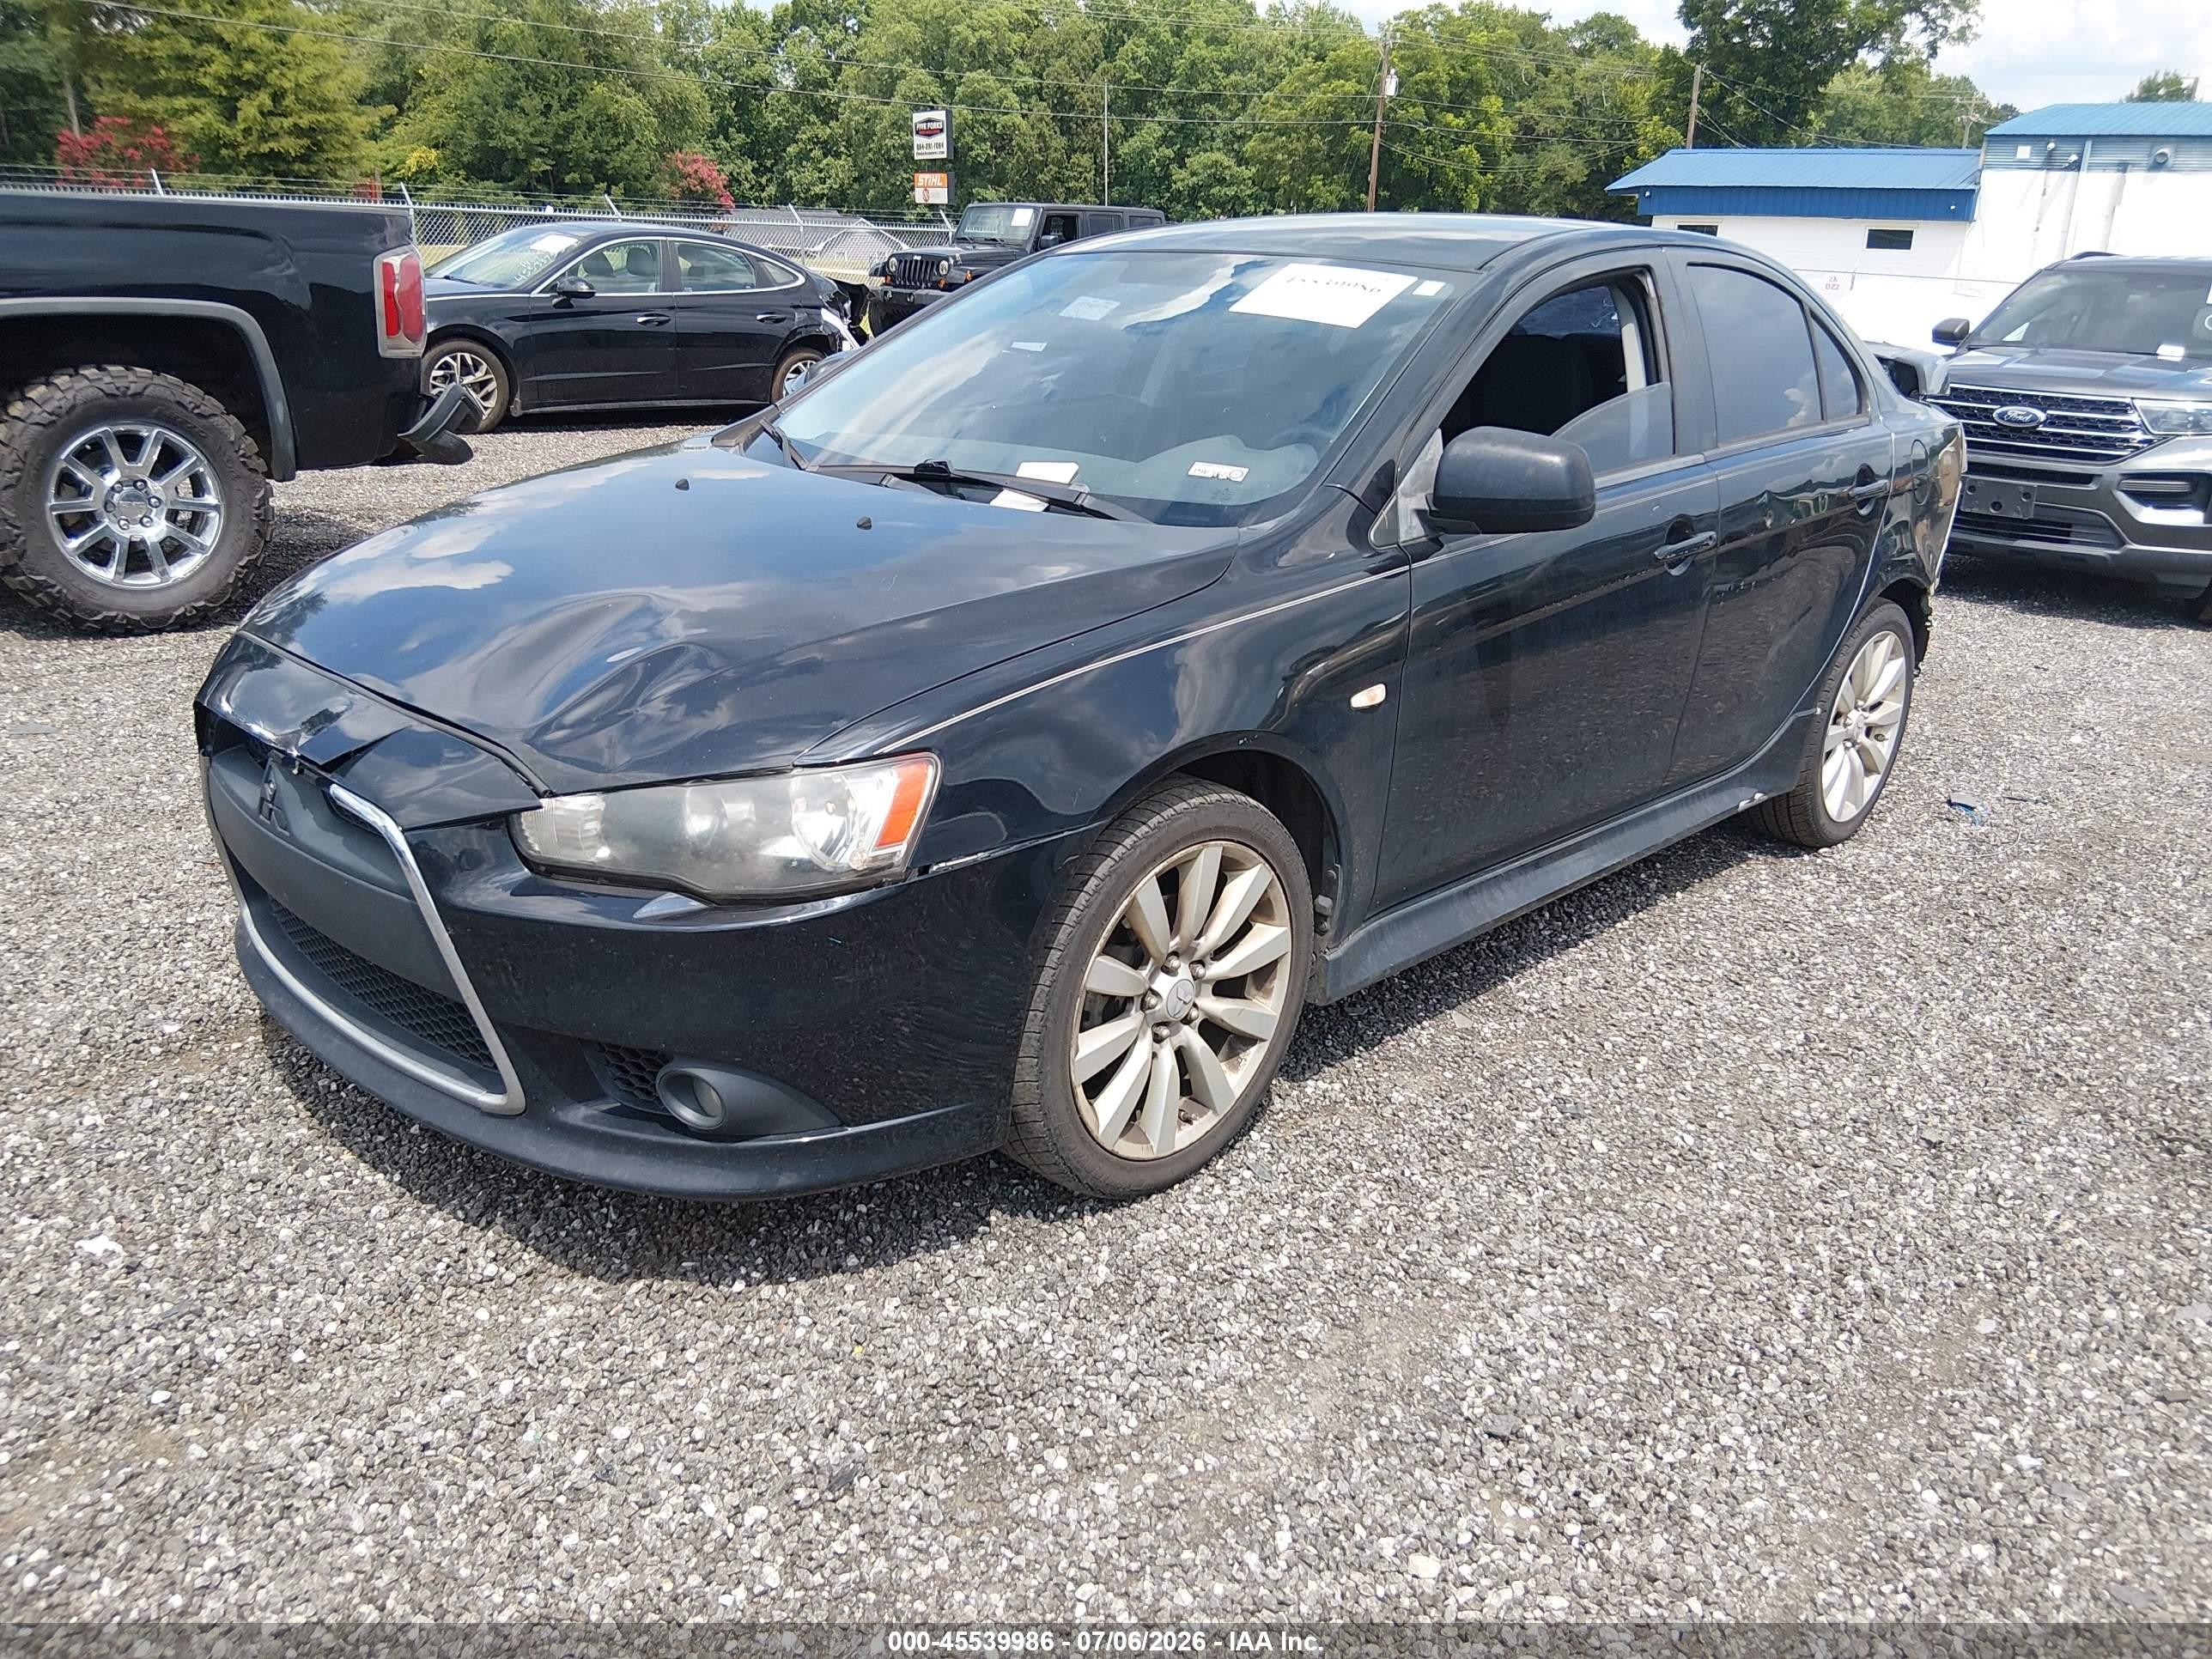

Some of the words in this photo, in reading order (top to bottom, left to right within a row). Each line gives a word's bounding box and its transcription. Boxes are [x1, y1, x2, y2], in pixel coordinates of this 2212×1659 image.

[916, 123, 927, 131] FIVE
[927, 121, 943, 130] FORKS
[918, 175, 943, 186] STIHL
[2002, 410, 2032, 422] Ford
